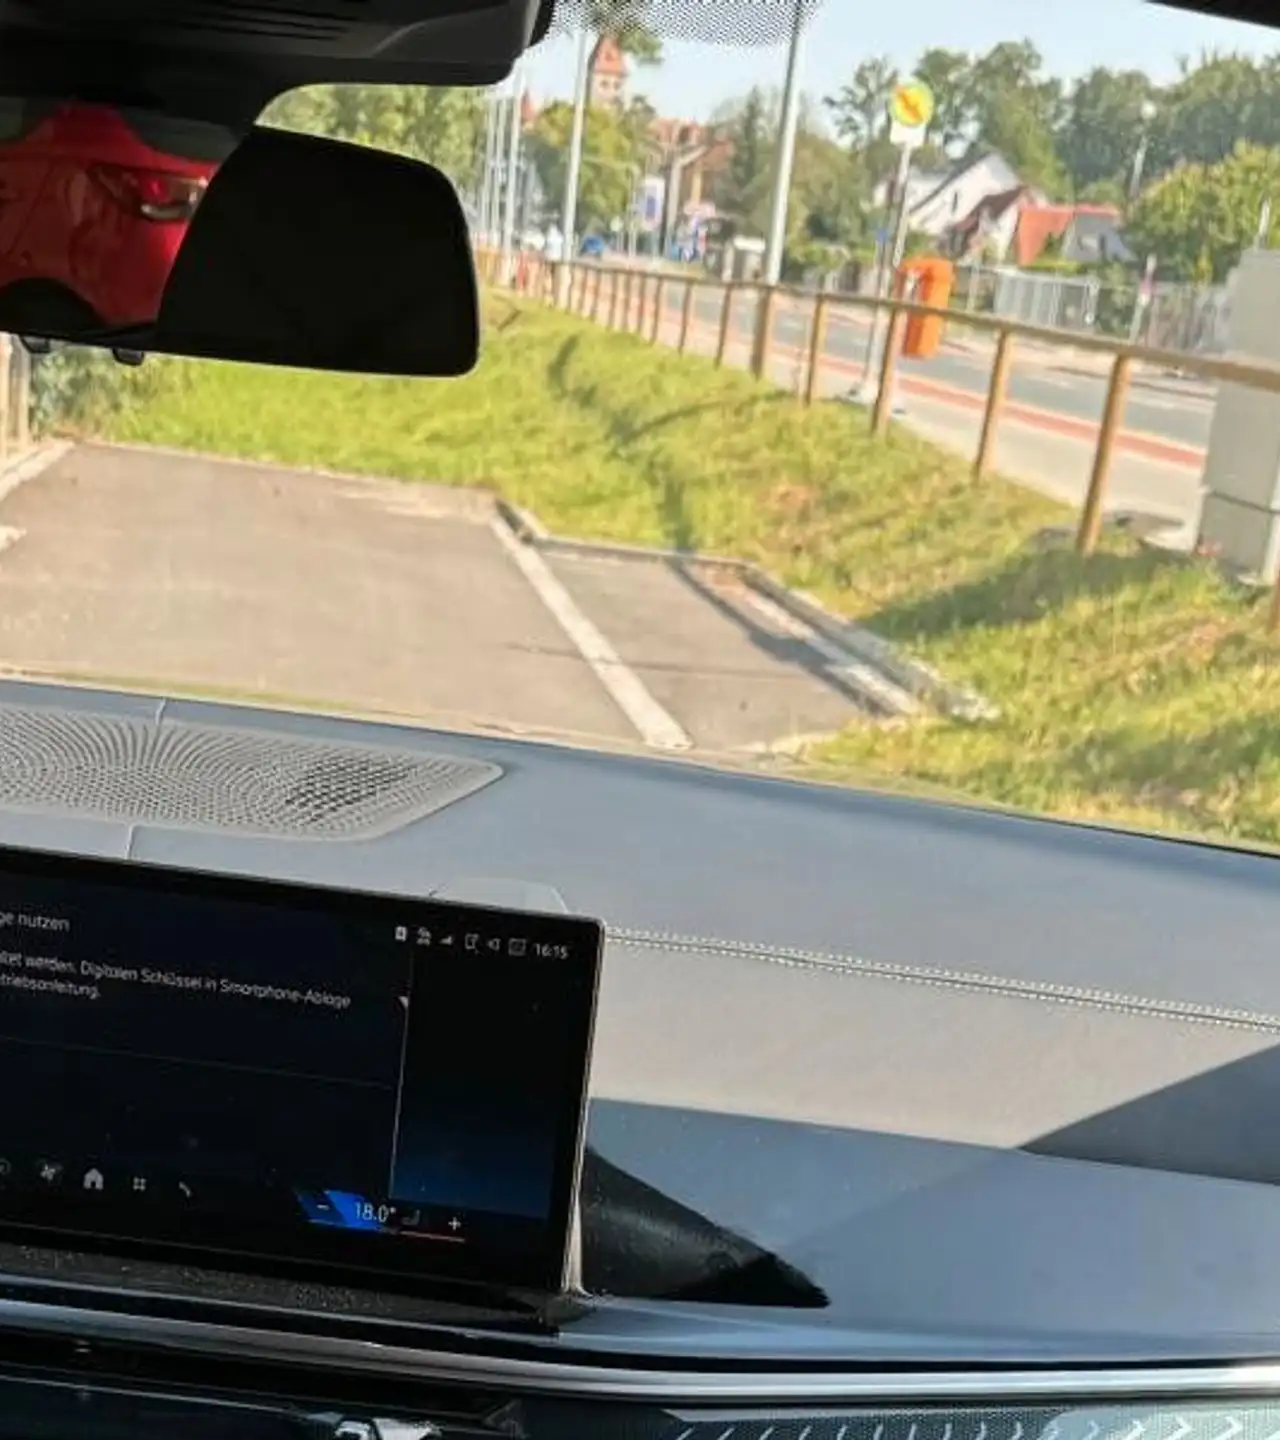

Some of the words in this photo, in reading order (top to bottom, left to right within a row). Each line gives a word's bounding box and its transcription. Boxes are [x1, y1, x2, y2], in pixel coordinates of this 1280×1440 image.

[18, 912, 70, 931] nutzen
[535, 943, 569, 960] 16:15
[80, 959, 138, 981] Digitalen
[140, 967, 202, 988] Schlüssel
[204, 975, 218, 992] in
[219, 978, 351, 1009] Smartphone-Ablage
